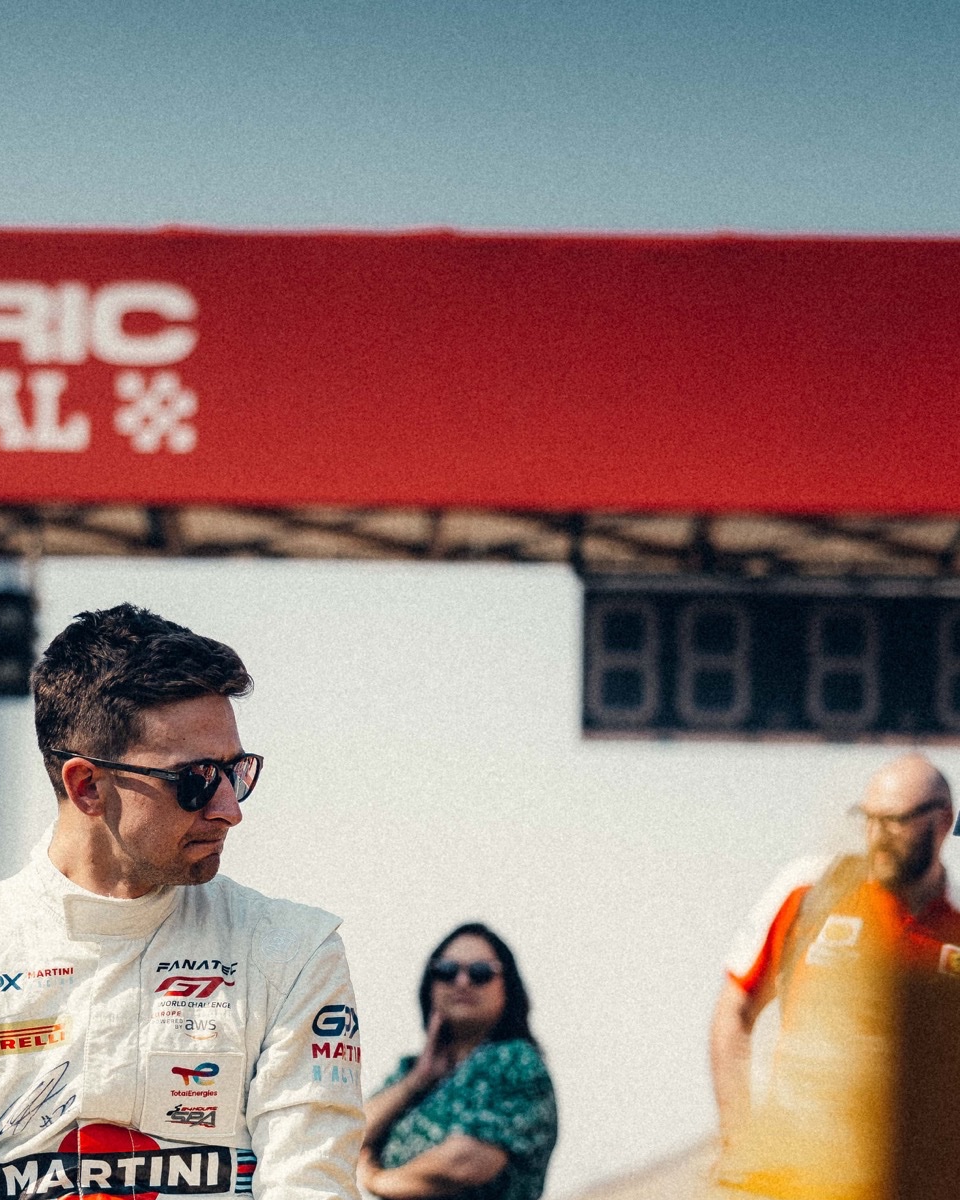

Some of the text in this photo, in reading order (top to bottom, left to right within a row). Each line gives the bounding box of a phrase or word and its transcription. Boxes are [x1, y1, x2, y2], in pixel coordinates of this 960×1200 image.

[28, 967, 74, 979] MARTINI
[156, 959, 238, 975] FANATEC
[154, 976, 235, 998] GT
[188, 1001, 231, 1009] CHALENGE
[185, 1019, 217, 1031] aws
[170, 1089, 218, 1098] TotalEnergies
[2, 1151, 219, 1196] MARTINI
